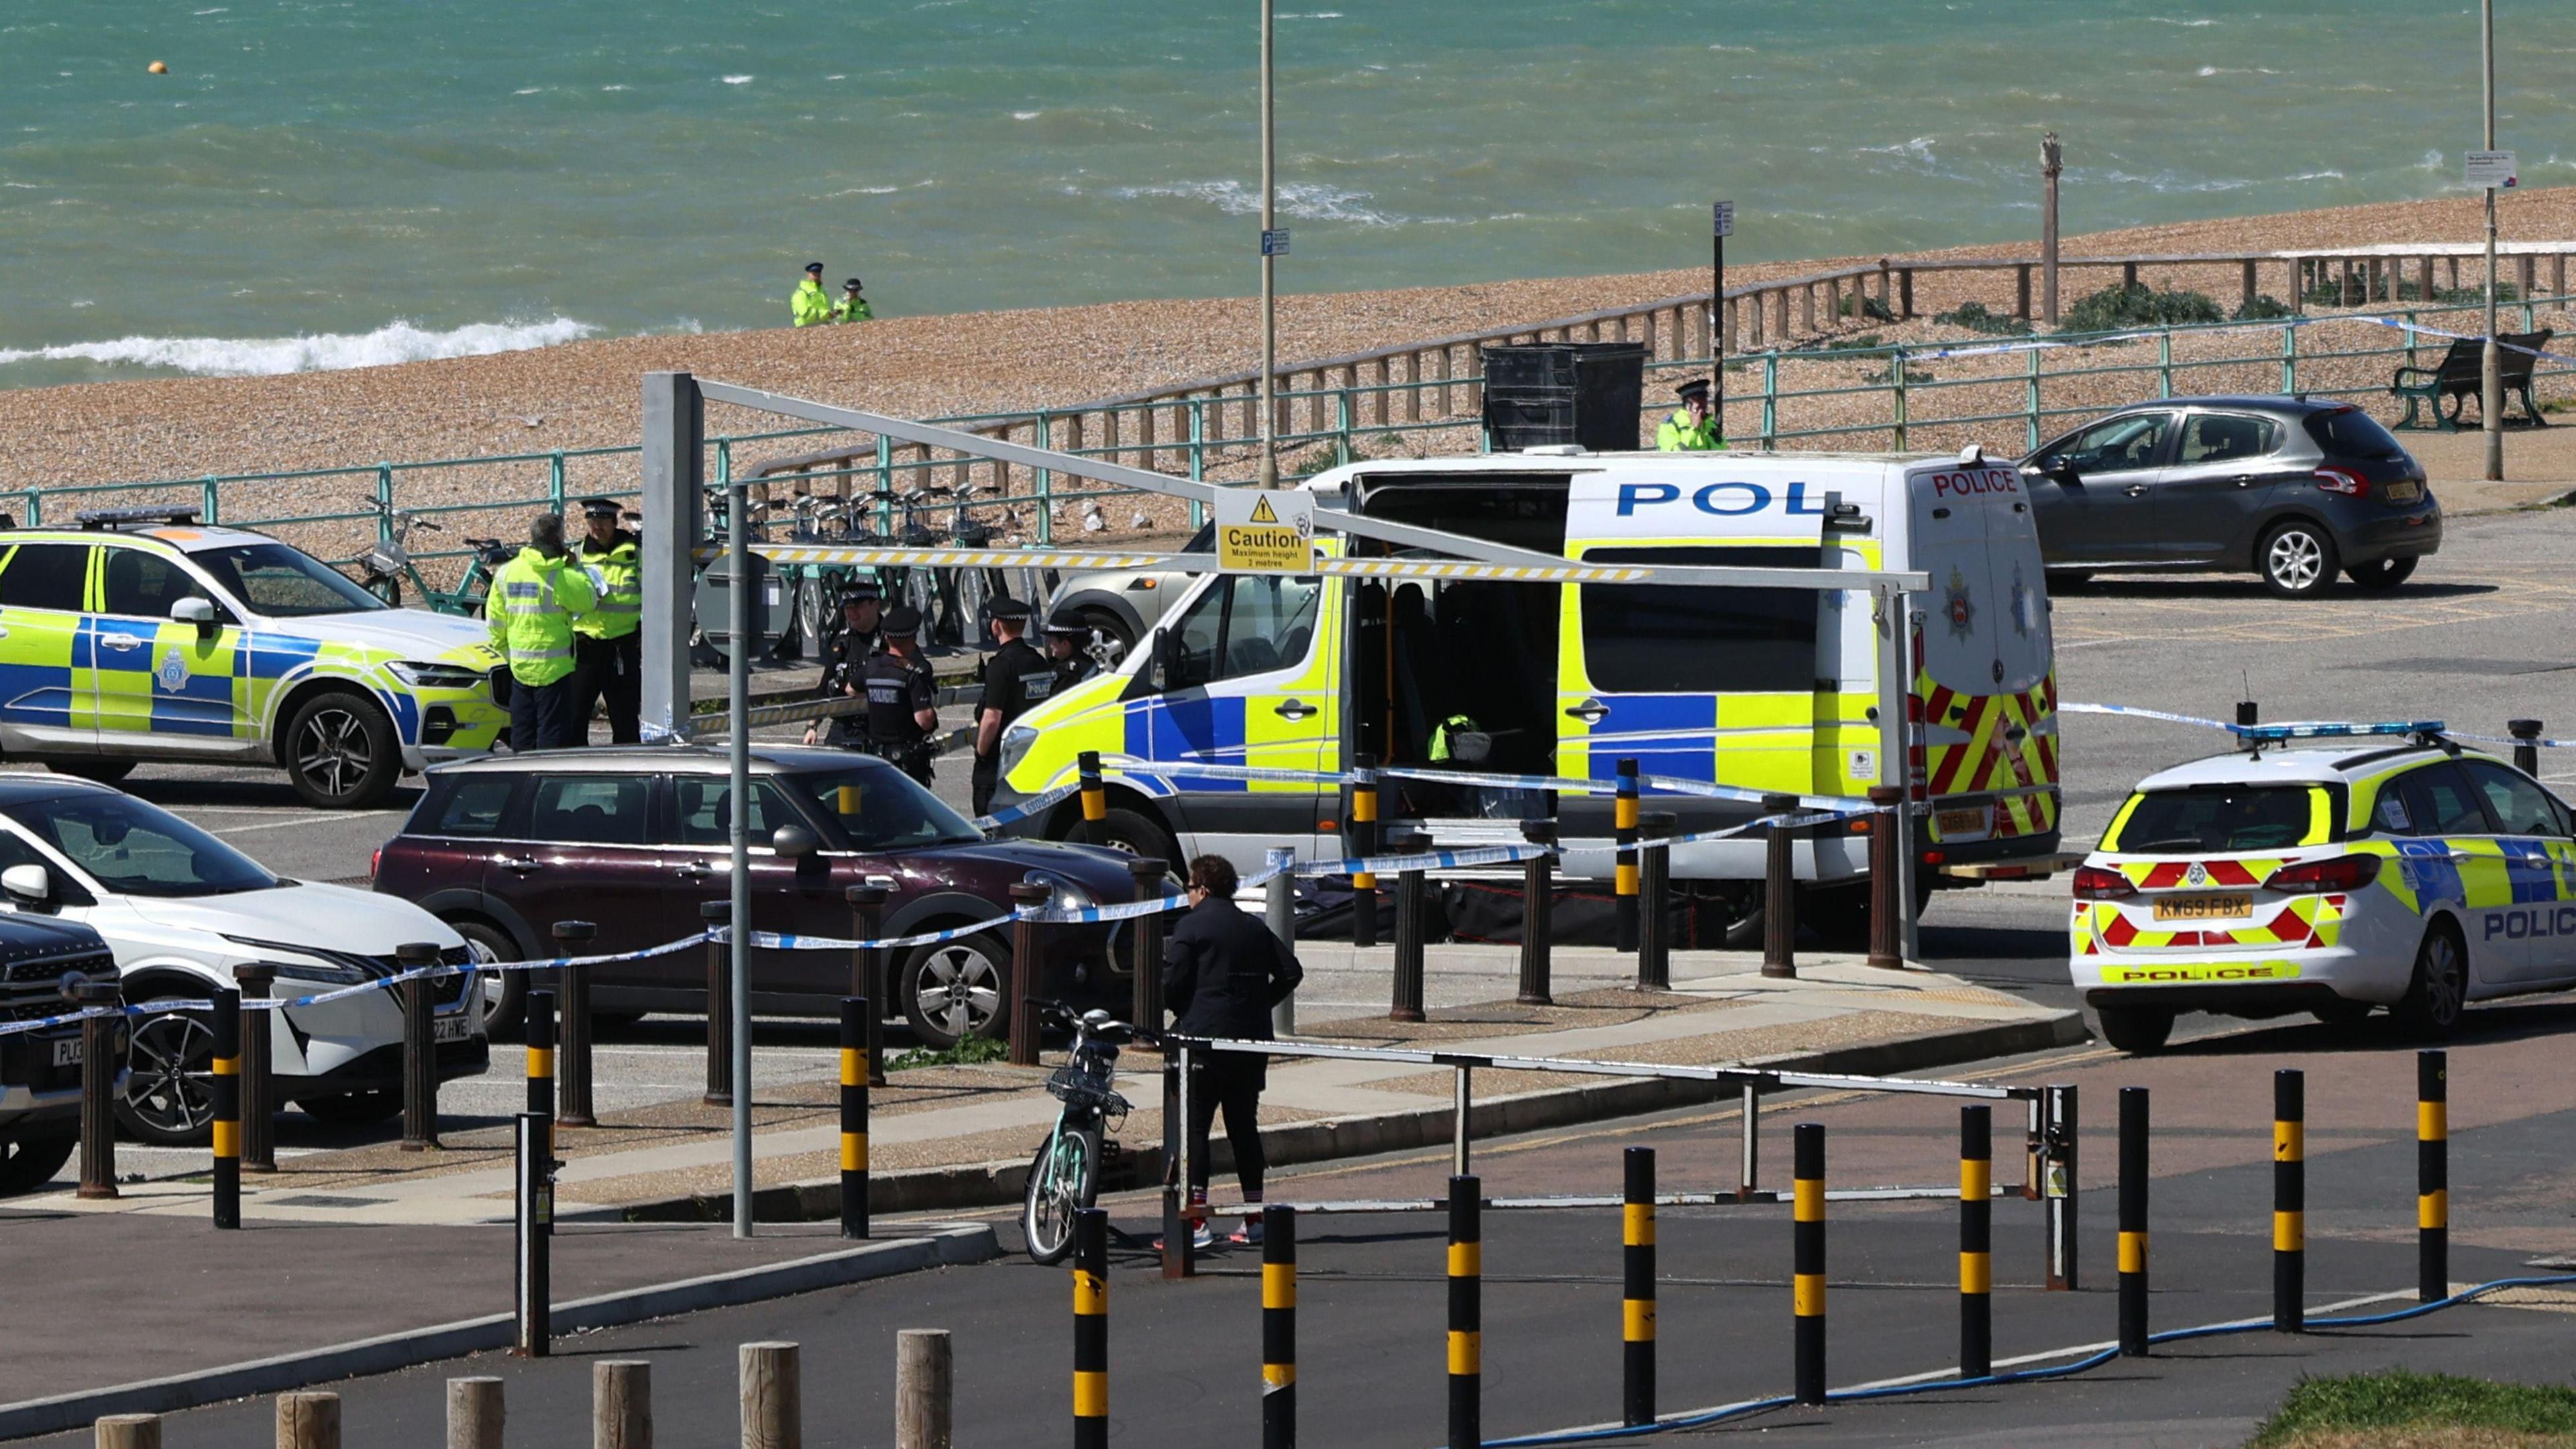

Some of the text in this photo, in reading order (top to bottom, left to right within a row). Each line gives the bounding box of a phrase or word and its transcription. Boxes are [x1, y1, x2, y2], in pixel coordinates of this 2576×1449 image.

[1265, 234, 1271, 252] P
[1932, 470, 2018, 497] POLICE
[1229, 529, 1301, 547] Caution
[1232, 549, 1297, 559] Maximum height
[868, 688, 897, 703] POLICE
[1026, 794, 1051, 814] CROSS
[2160, 898, 2245, 918] KW69 FBX
[2123, 967, 2273, 981] POLICE
